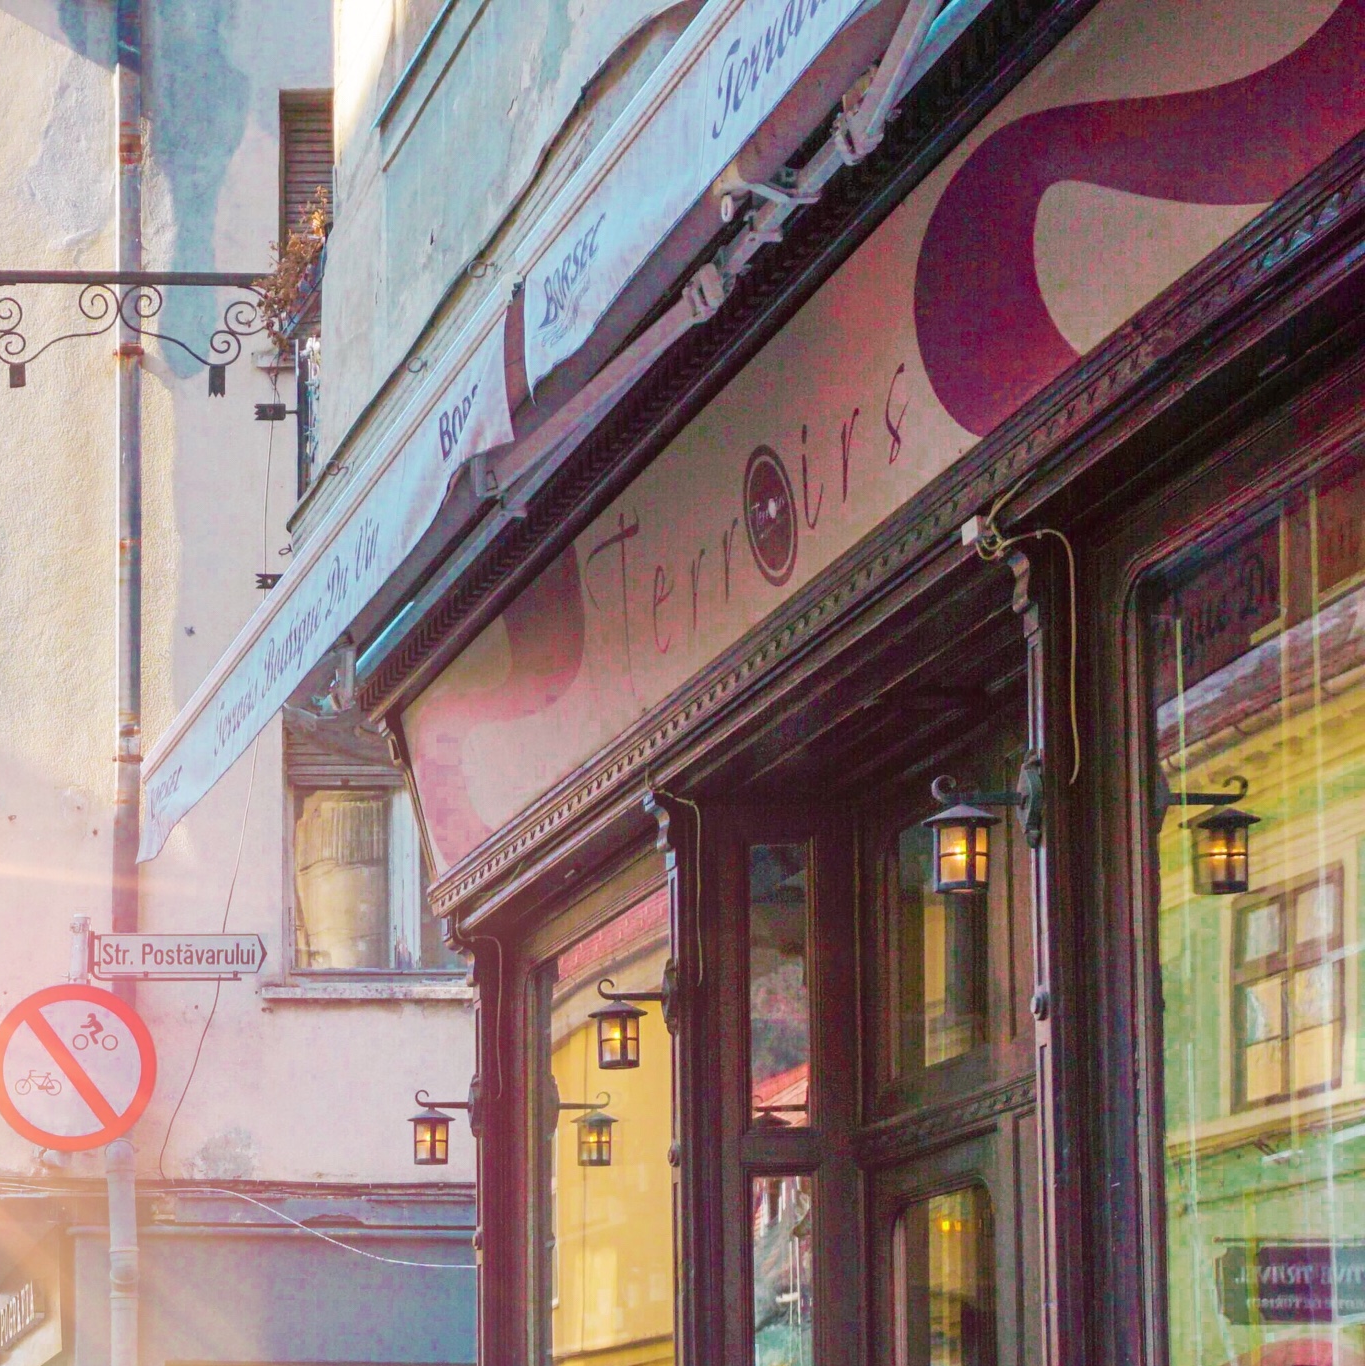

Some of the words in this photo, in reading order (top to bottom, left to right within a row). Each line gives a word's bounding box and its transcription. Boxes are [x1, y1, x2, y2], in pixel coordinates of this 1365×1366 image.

[539, 212, 606, 329] BORSEC
[262, 600, 322, 699] Boutique
[325, 555, 349, 621] Du
[102, 942, 134, 966] Str.
[141, 942, 256, 966] Postăvarului
